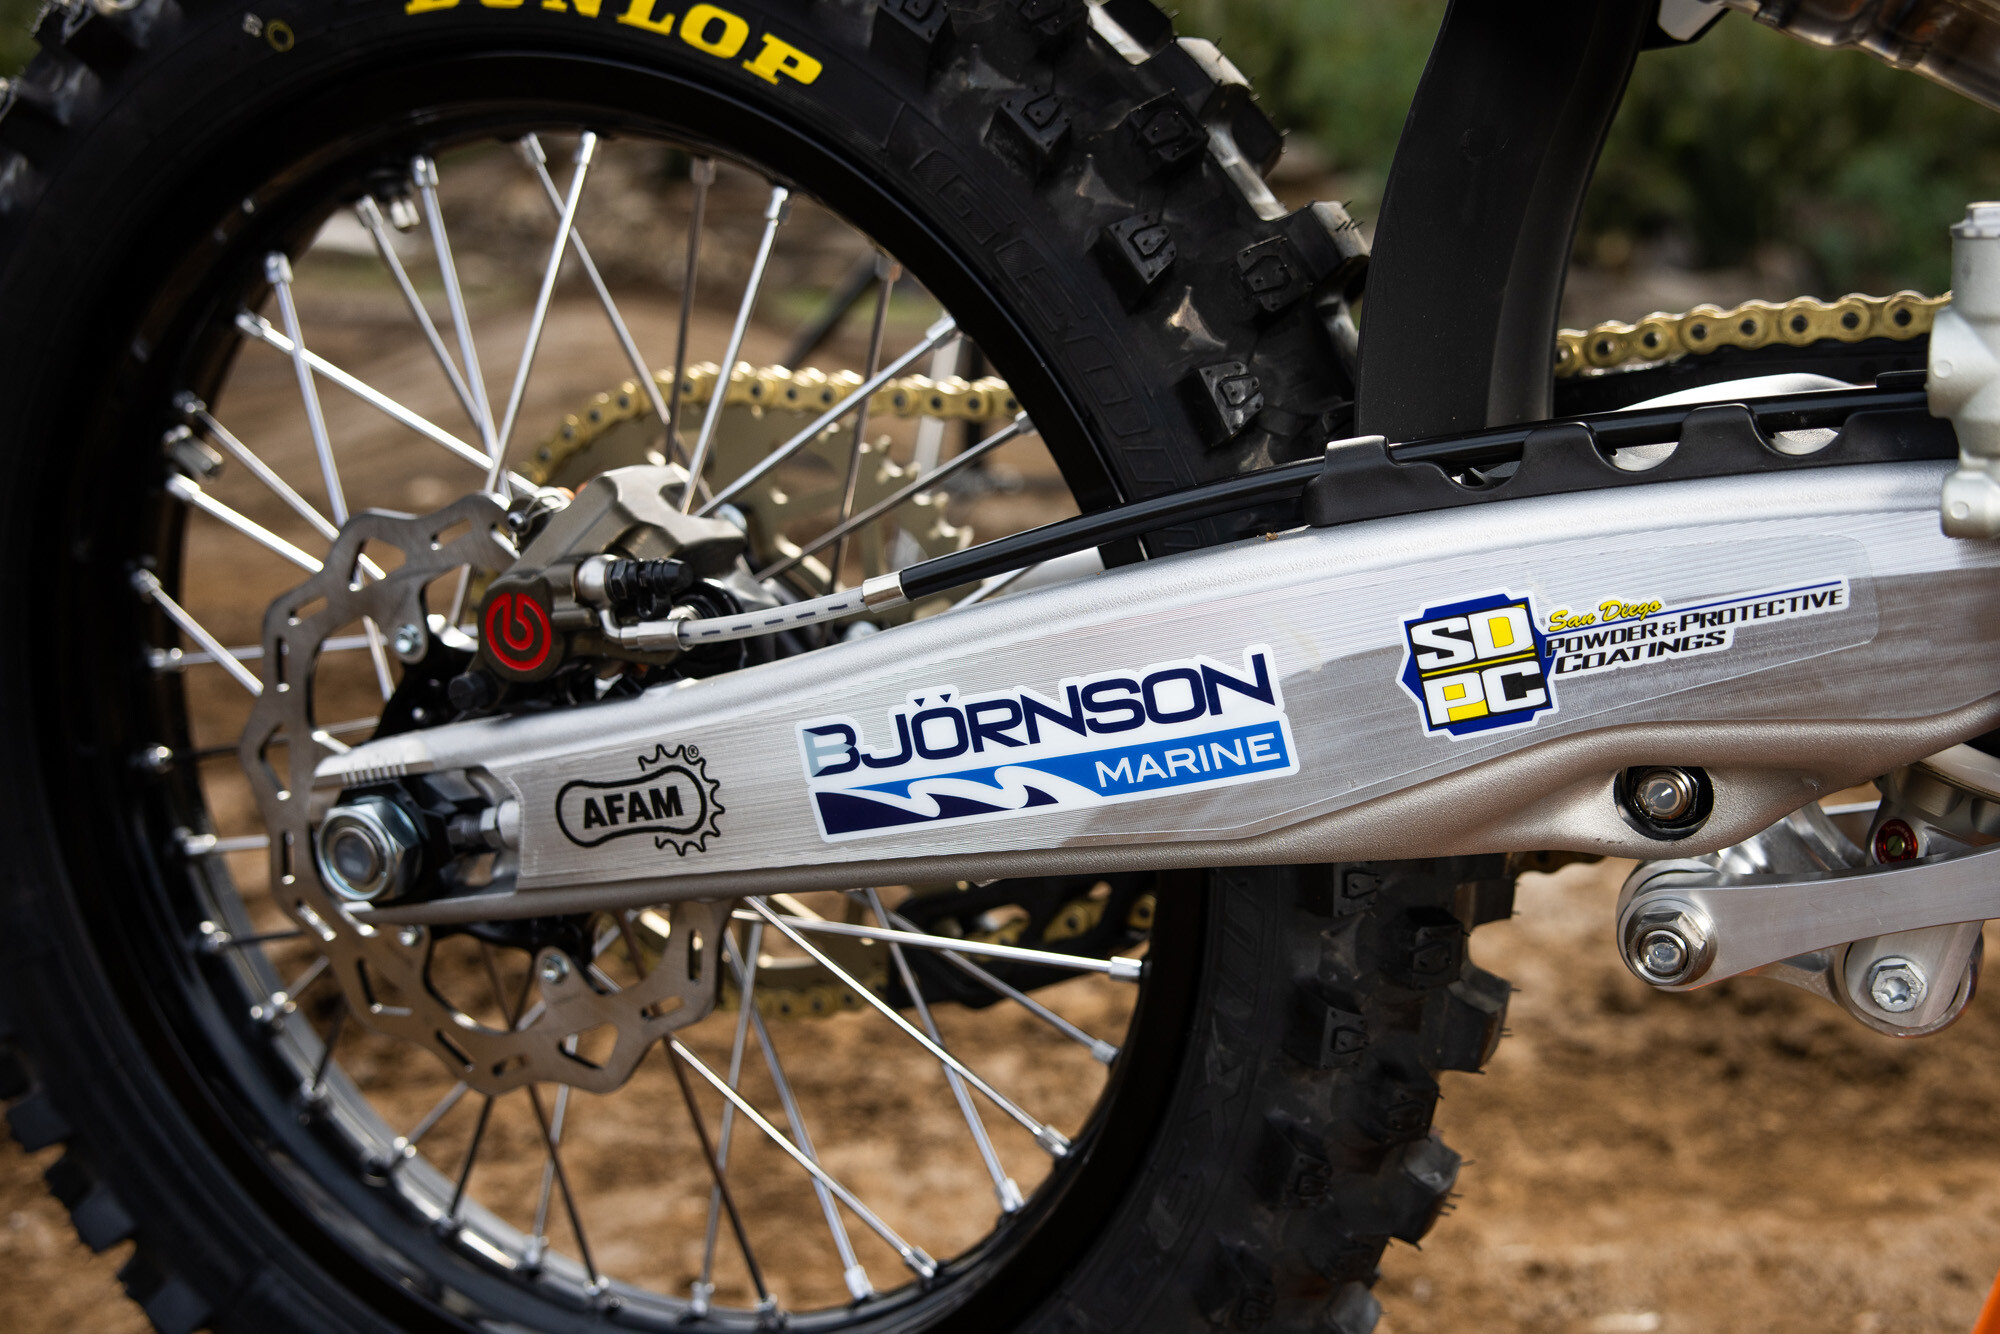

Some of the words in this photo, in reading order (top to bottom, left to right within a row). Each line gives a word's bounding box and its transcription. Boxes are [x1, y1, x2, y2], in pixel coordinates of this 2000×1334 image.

[1545, 622, 1659, 657] POWDER
[1680, 588, 1844, 631] PROTECTIVE
[1549, 609, 1596, 632] San
[1599, 598, 1662, 622] Diego
[1555, 630, 1726, 675] COATINGS
[802, 653, 1275, 777] BJÖRNSON
[1095, 732, 1281, 788] MARINE
[584, 785, 684, 829] AFAM
